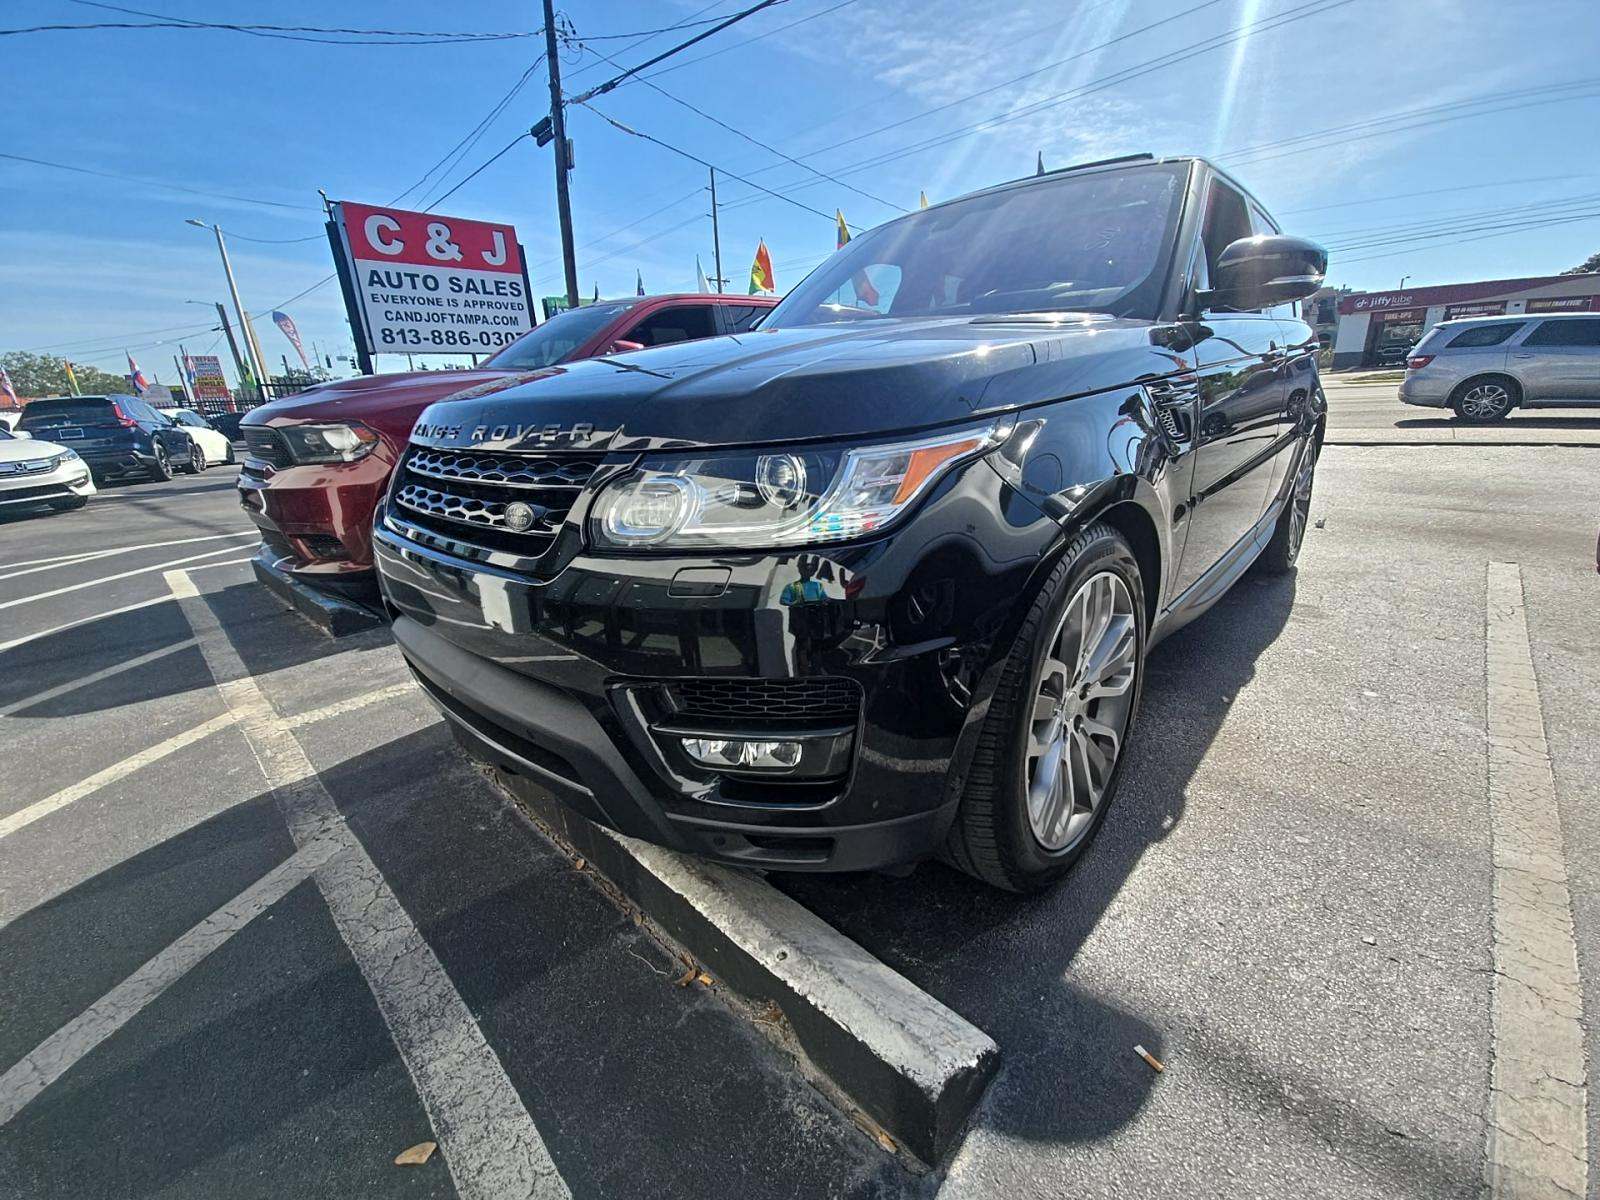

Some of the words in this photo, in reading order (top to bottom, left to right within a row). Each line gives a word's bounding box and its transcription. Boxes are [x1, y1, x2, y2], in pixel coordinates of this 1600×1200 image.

[364, 214, 405, 256] C
[425, 222, 464, 262] &
[481, 231, 507, 266] J
[368, 269, 440, 292] AUTO
[448, 276, 522, 297] SALES
[371, 293, 443, 307] EVERYONE
[447, 298, 459, 308] IS
[463, 299, 525, 311] APPROVED
[384, 310, 520, 327] CANDJOFTAMPA.COM
[381, 328, 523, 346] 813-886-030
[414, 424, 462, 440] ANGE
[471, 422, 596, 441] ROVER
